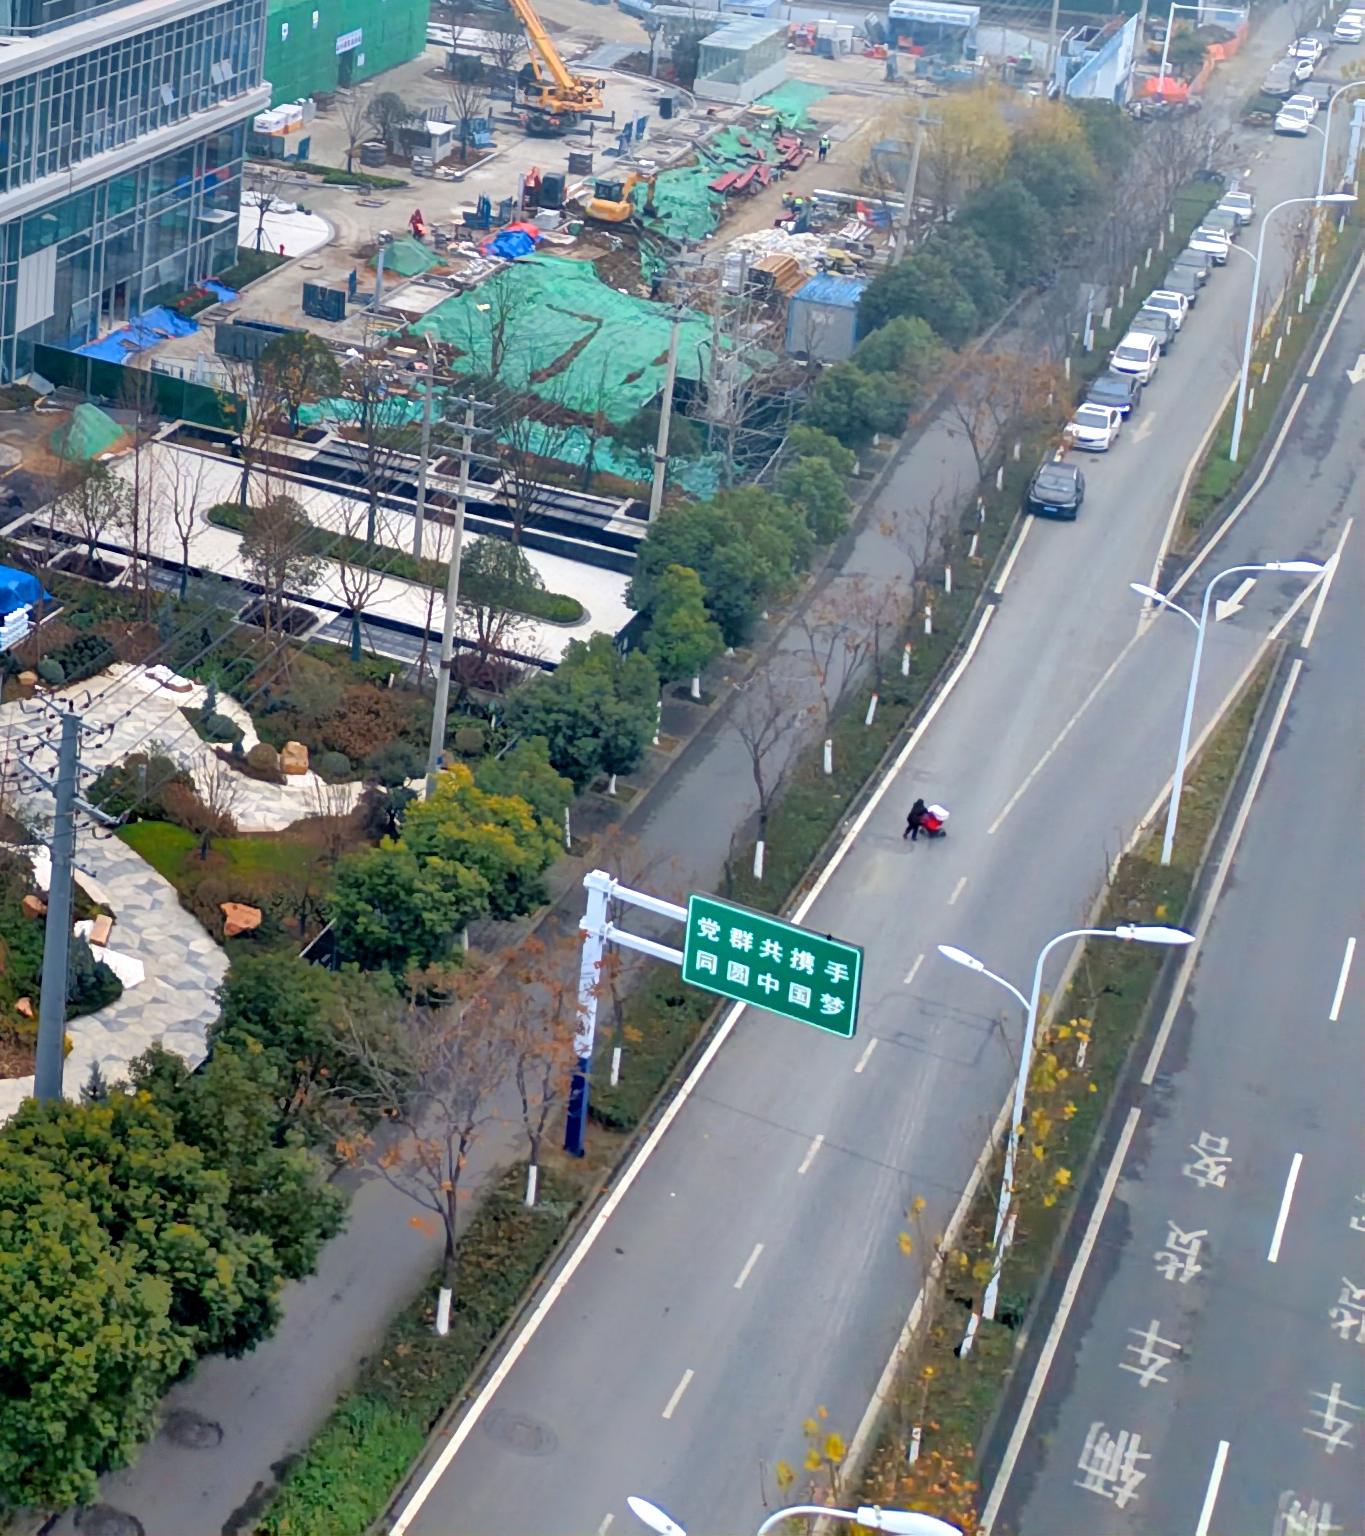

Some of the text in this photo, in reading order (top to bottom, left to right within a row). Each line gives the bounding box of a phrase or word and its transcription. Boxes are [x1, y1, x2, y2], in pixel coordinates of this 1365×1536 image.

[696, 950, 845, 1016] 同圆中国梦
[697, 917, 850, 984] 党群共携手
